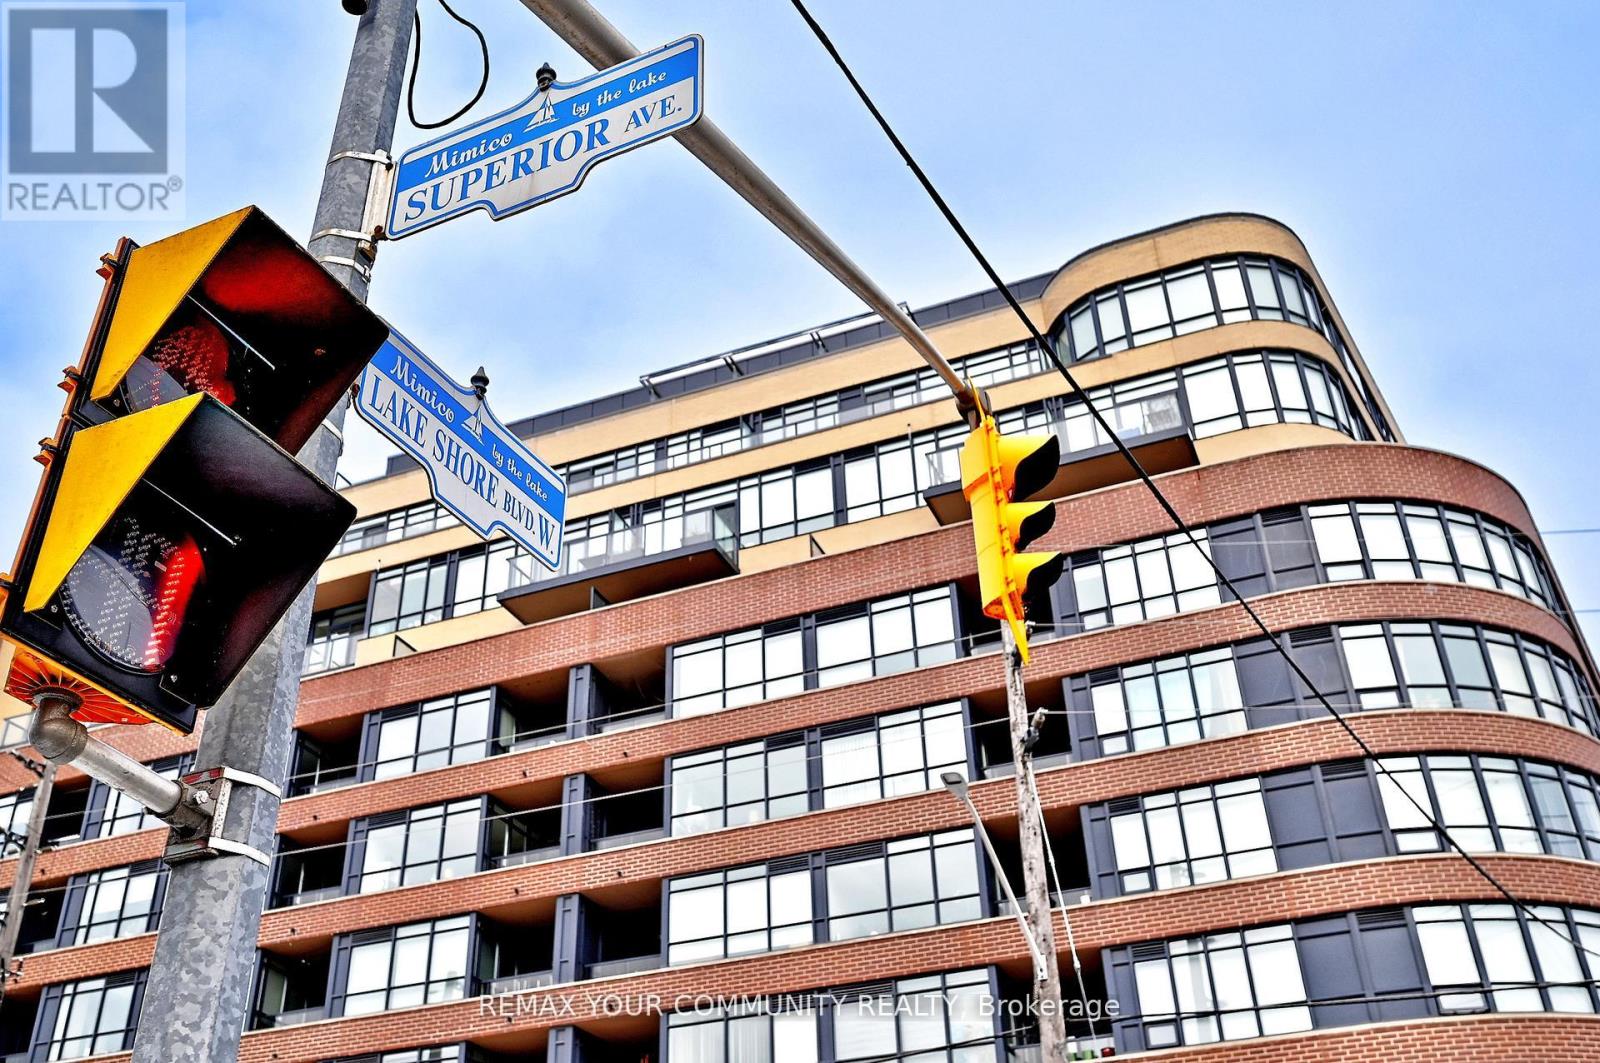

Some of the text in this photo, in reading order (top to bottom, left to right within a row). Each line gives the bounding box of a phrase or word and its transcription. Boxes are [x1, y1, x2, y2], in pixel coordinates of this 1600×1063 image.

[572, 70, 667, 116] by the lake
[404, 94, 683, 222] SUPERIOR AVE.
[424, 130, 513, 177] Mimico
[390, 356, 456, 423] Mimico
[368, 374, 556, 555] LAKE SHORE BLVD. W.
[491, 443, 549, 502] by the lake
